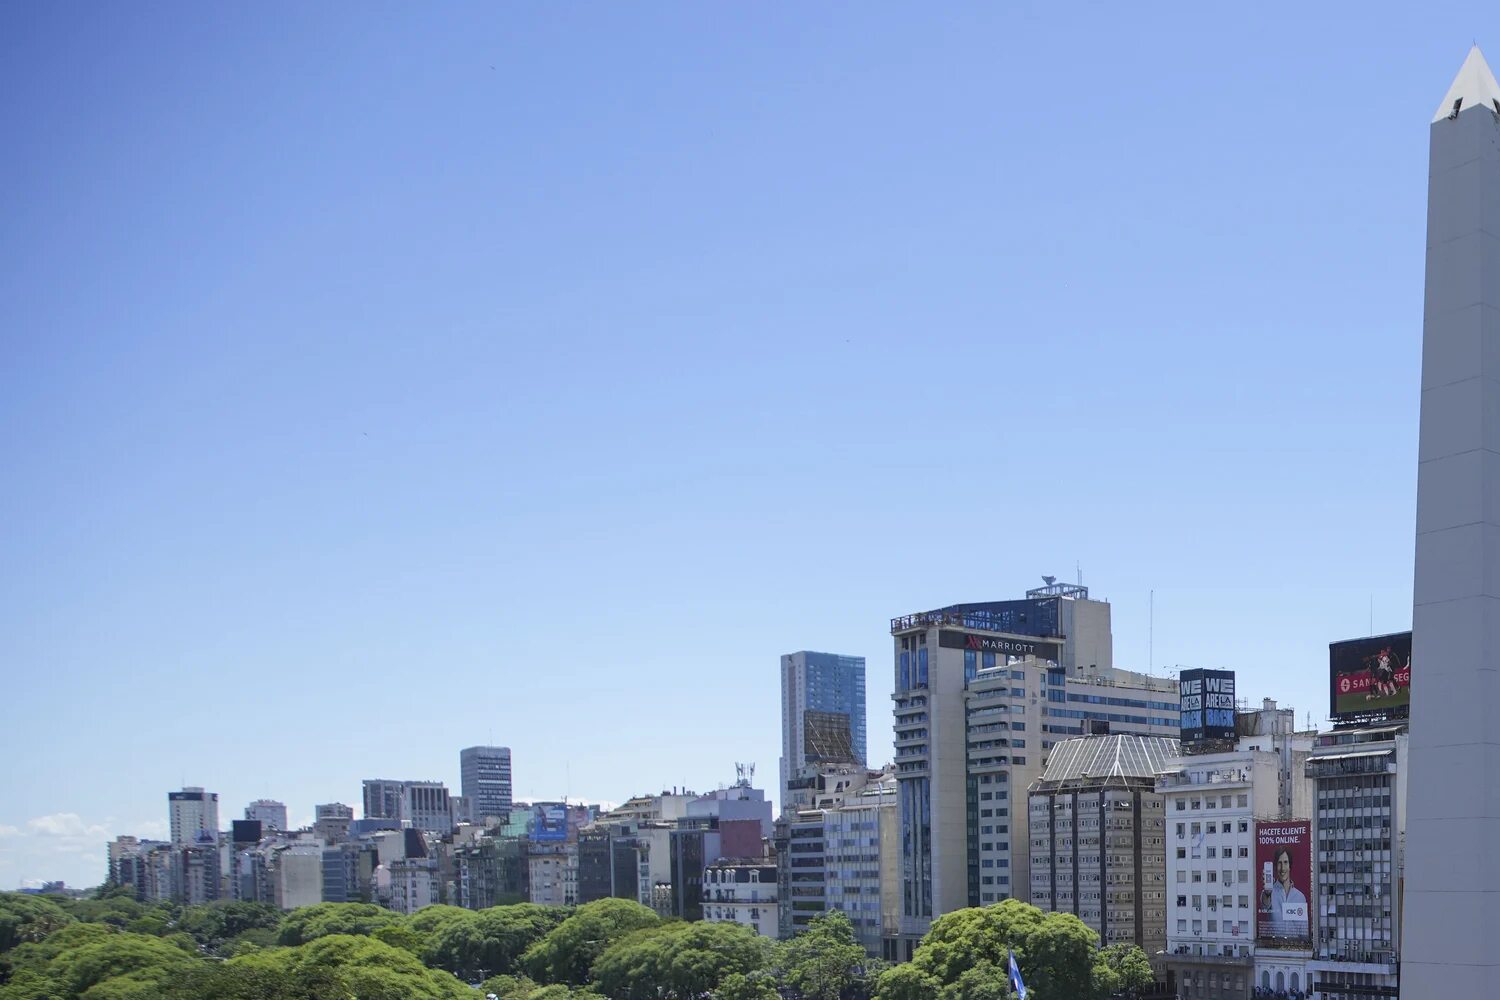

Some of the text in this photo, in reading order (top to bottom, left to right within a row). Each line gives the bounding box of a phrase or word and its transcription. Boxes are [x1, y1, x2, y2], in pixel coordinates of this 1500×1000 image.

[982, 639, 1035, 653] MARRIOTT
[1352, 678, 1371, 689] SAN
[1393, 672, 1409, 683] SEG
[1181, 680, 1201, 695] WE
[1206, 678, 1234, 693] WE
[1206, 693, 1219, 708] ARE
[1259, 826, 1306, 836] HACETE CLIENTE
